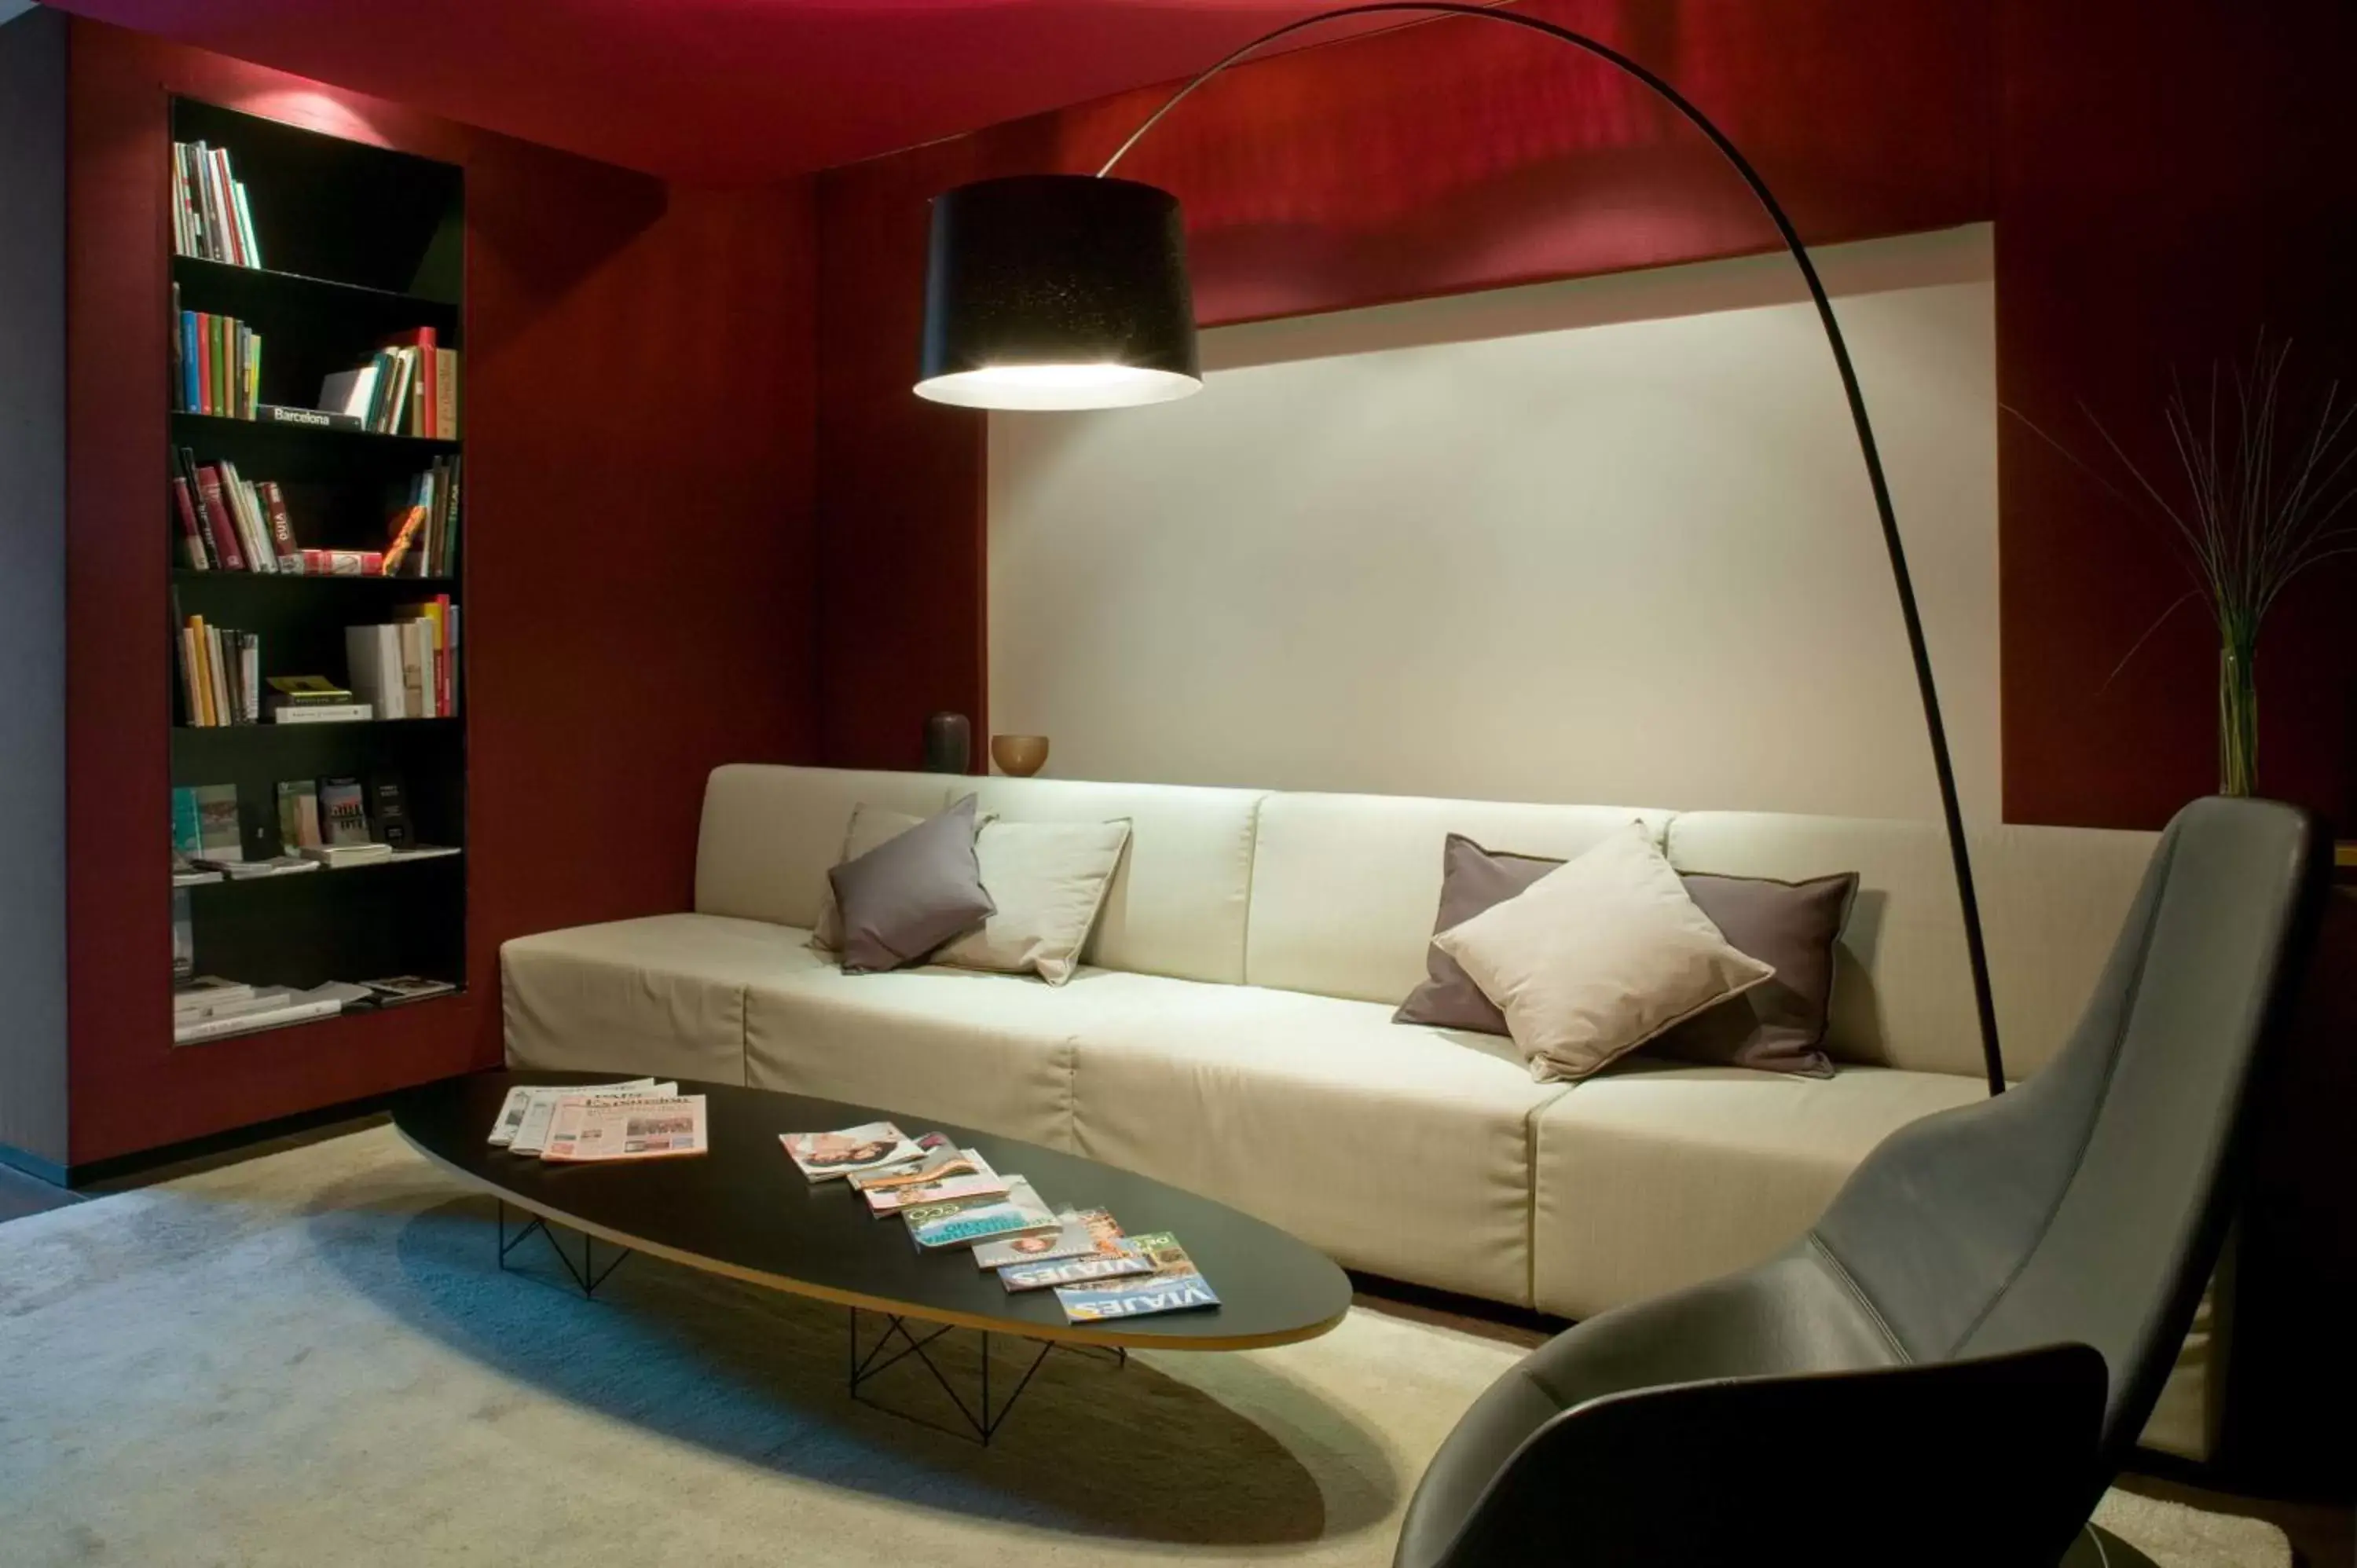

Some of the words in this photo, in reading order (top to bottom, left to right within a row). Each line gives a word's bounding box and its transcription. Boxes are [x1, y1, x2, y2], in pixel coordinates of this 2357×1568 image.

[274, 407, 330, 427] Barcelona
[1012, 1258, 1139, 1284] VIAJES
[1075, 1288, 1211, 1316] VIAJES
